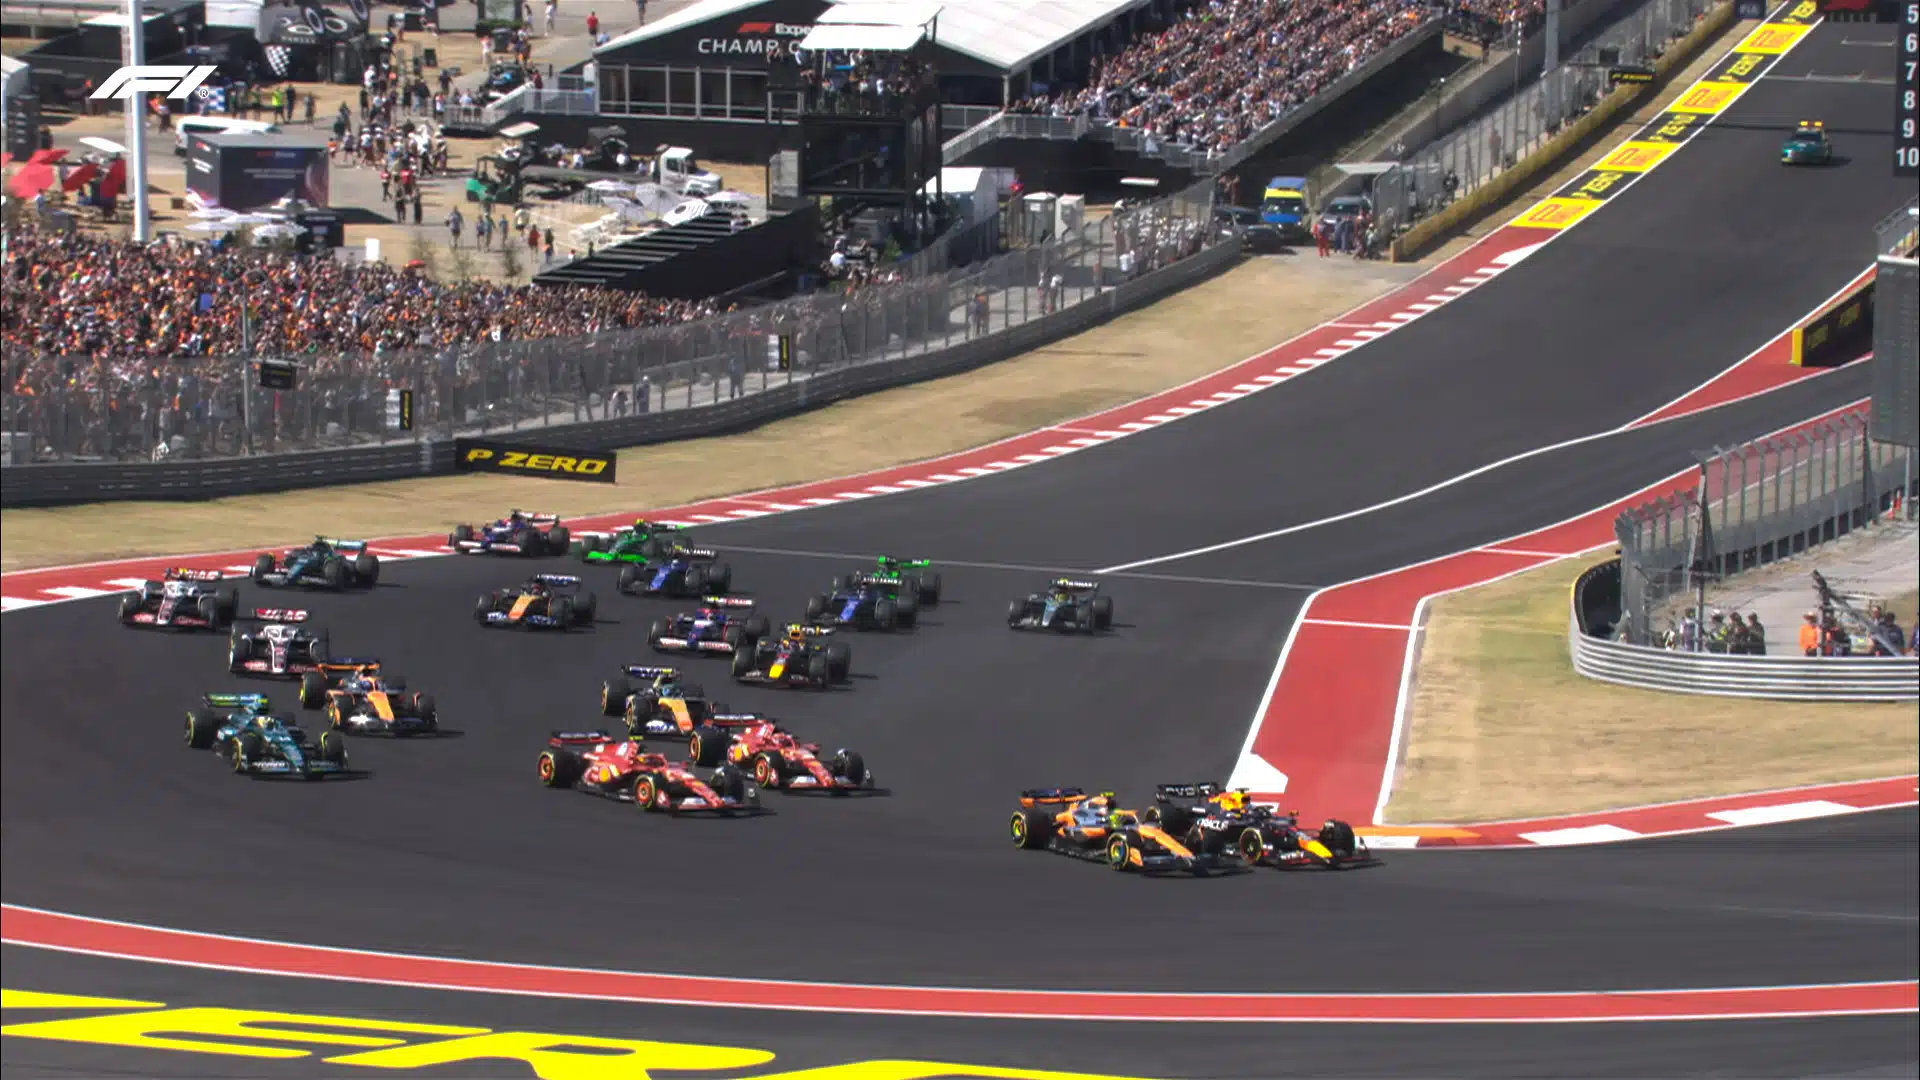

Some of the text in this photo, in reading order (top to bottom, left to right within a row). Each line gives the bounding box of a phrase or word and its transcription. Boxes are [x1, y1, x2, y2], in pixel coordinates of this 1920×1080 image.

[1907, 4, 1919, 24] 5
[698, 38, 800, 53] CHAMPO
[1905, 33, 1918, 52] 6
[1904, 62, 1917, 81] 7
[1904, 90, 1916, 110] 8
[1903, 118, 1915, 138] 9
[1896, 147, 1919, 167] 10
[466, 448, 608, 475] P ZERO
